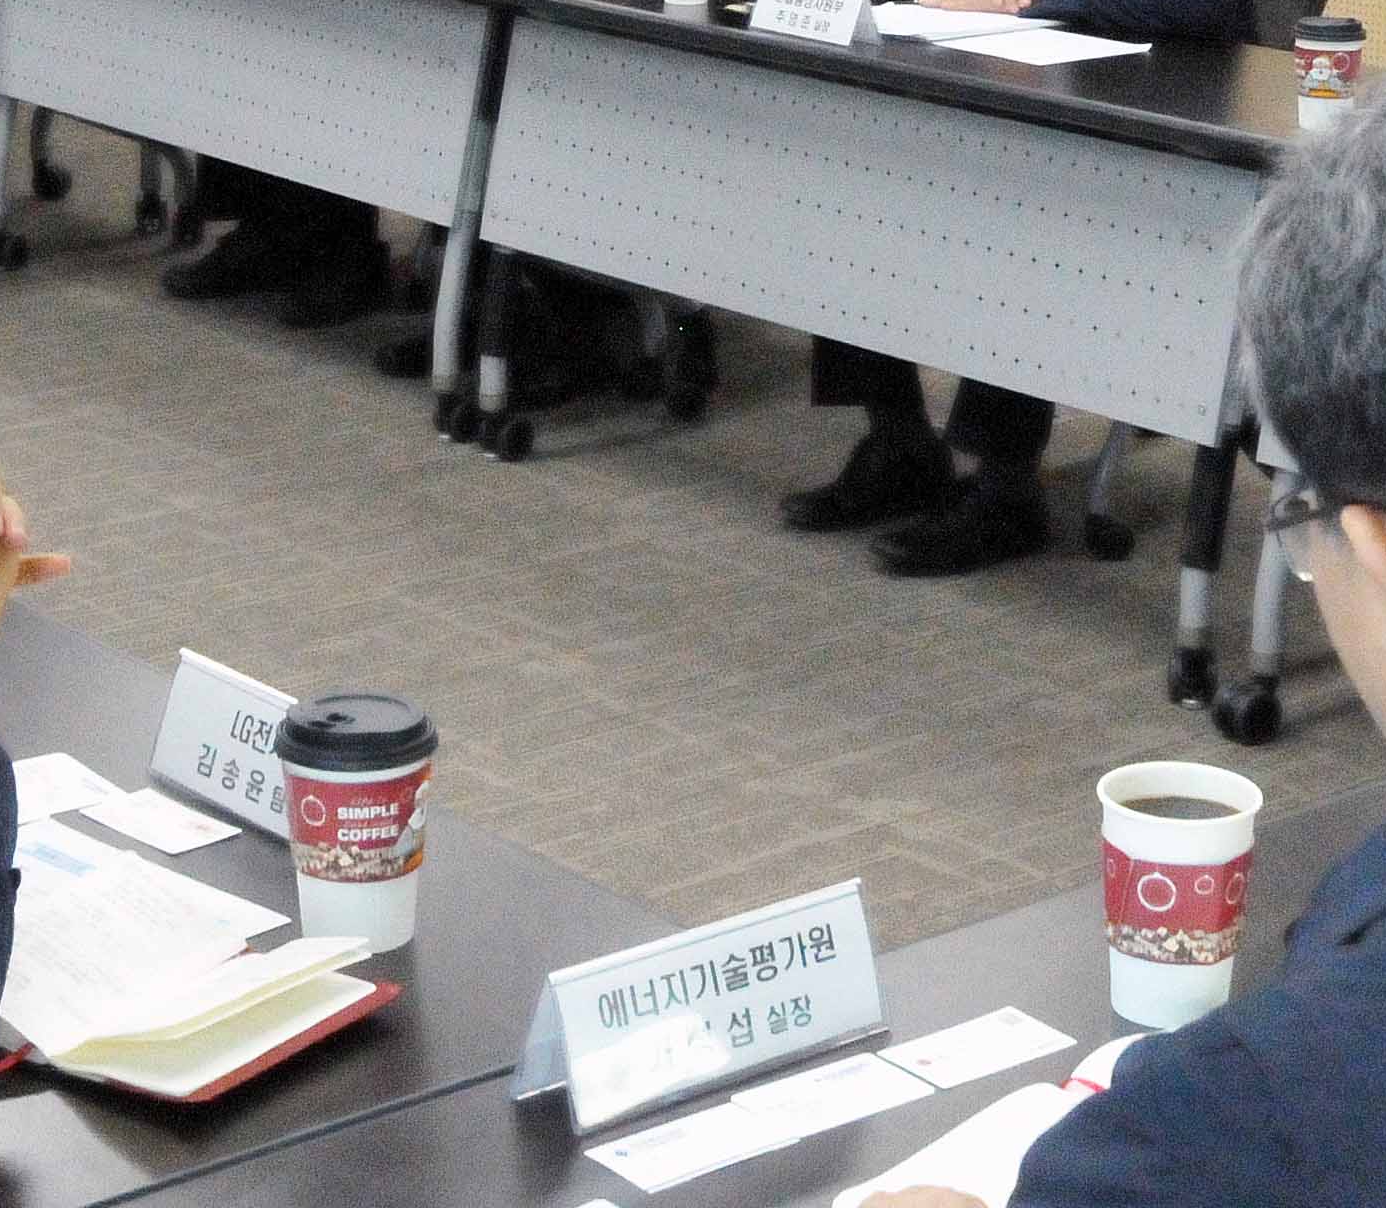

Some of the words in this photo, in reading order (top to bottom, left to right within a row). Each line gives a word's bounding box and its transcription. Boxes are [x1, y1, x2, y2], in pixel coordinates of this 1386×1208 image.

[230, 710, 277, 754] LG전
[338, 803, 399, 821] SIMPLE
[338, 824, 399, 842] COFFEE
[598, 923, 837, 1030] 에너지기술평가원
[766, 994, 813, 1035] 실장
